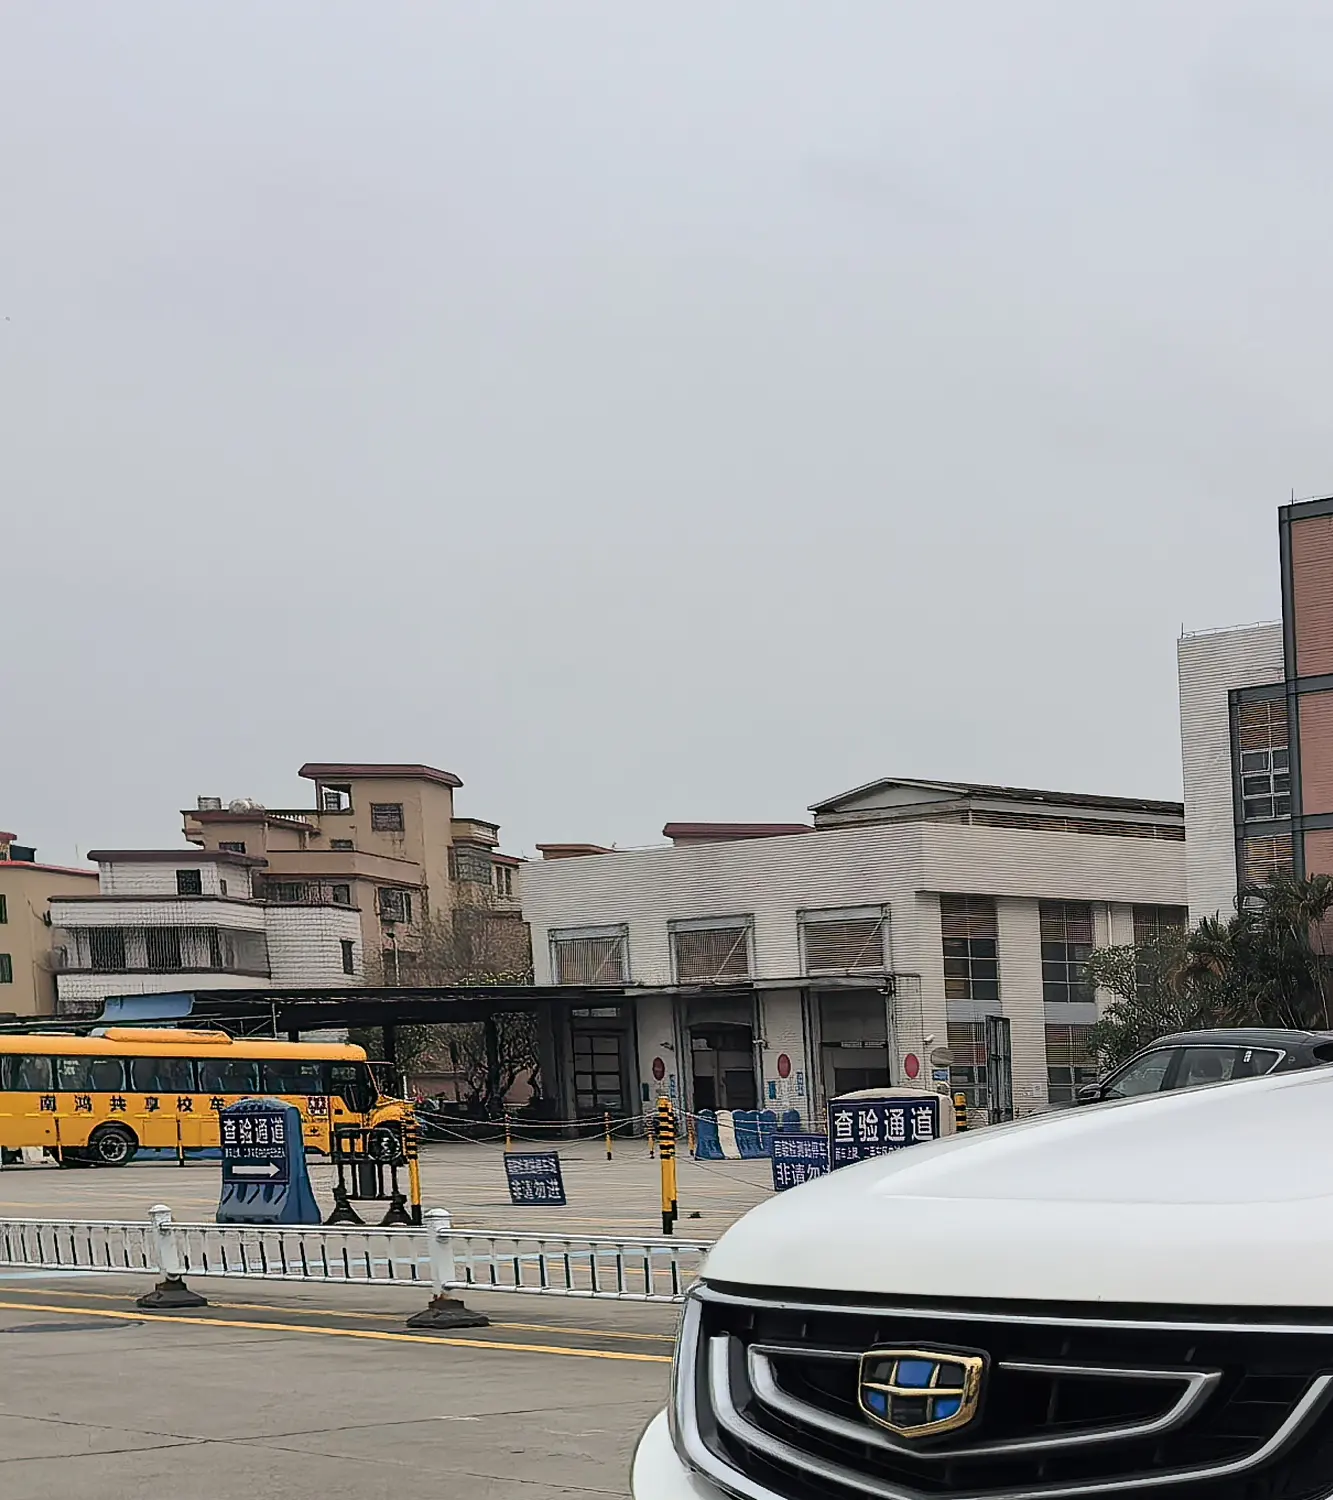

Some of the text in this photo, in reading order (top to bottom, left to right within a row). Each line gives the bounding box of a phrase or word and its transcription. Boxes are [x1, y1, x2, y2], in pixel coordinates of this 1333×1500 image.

[223, 1117, 286, 1144] 查验通道
[834, 1106, 934, 1142] 查验通道
